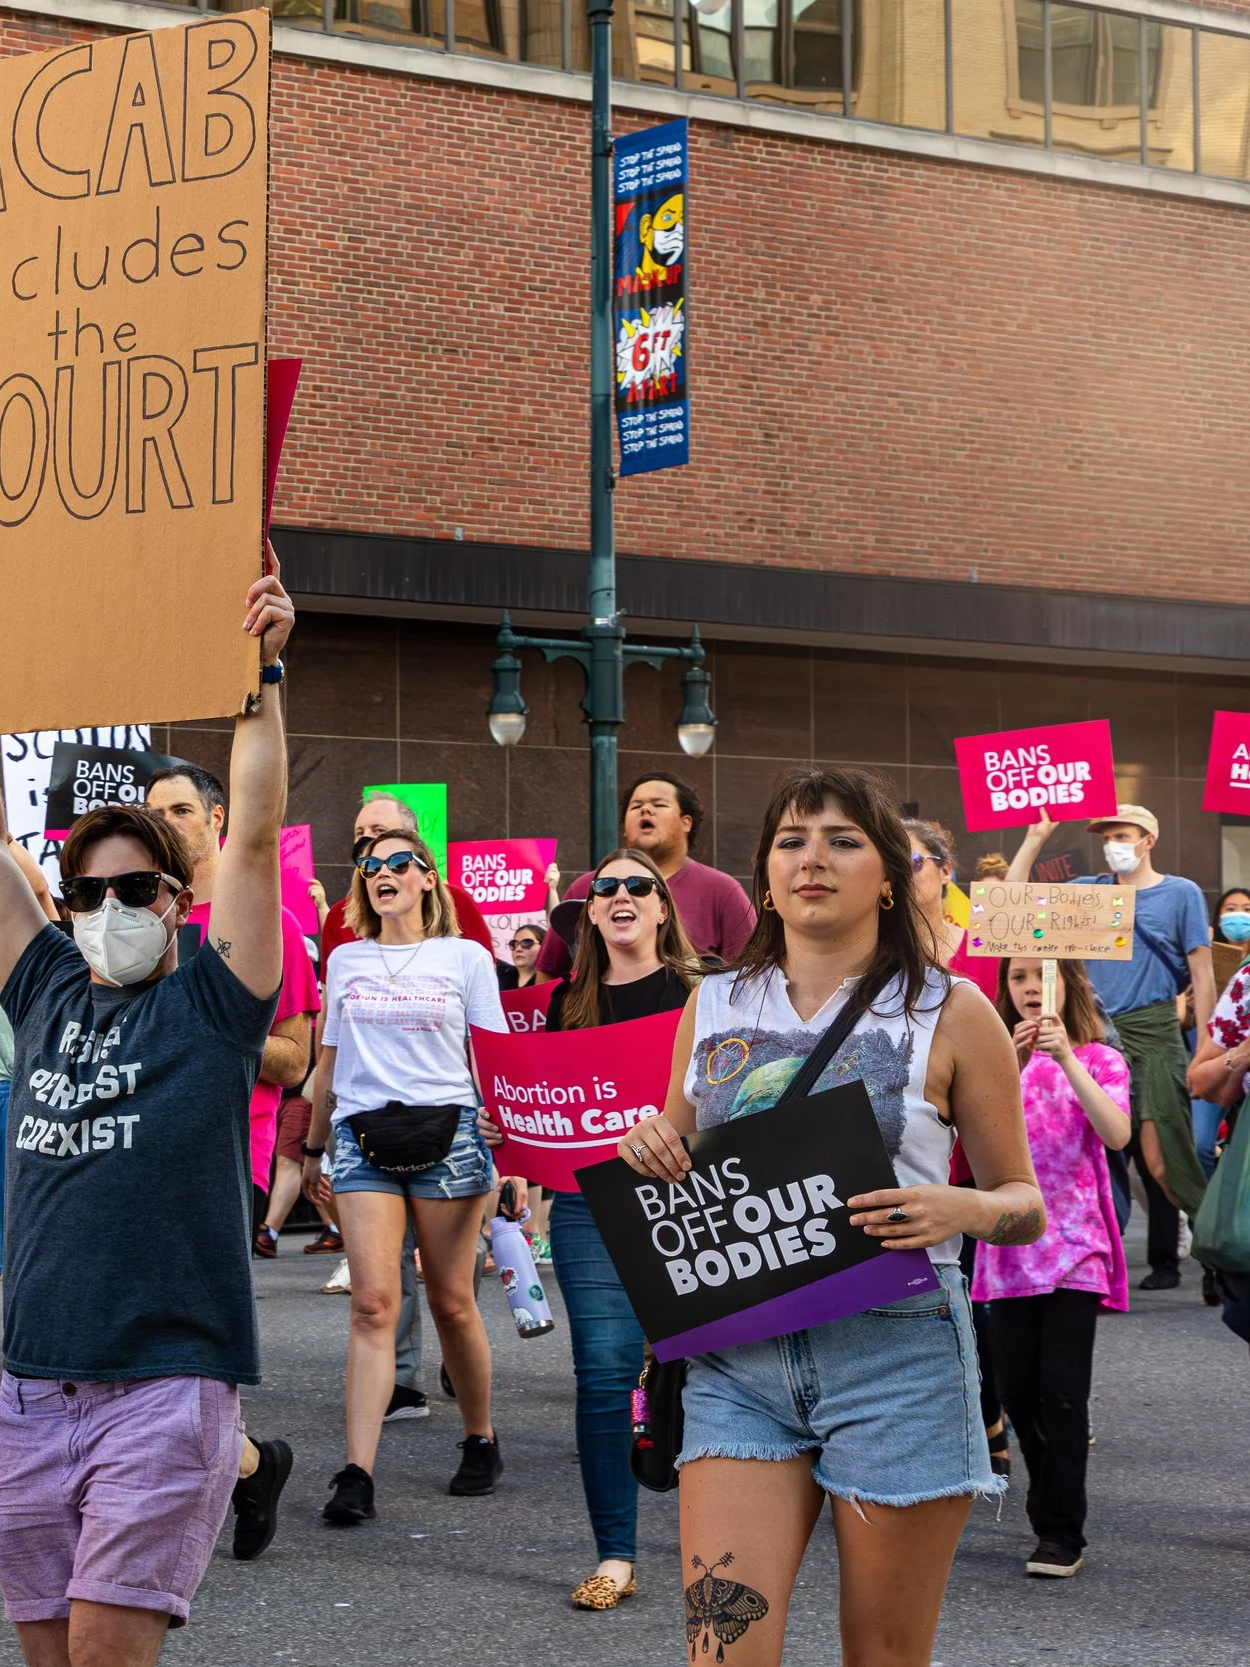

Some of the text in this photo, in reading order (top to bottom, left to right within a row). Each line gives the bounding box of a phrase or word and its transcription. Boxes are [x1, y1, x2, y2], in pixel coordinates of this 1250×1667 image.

[618, 166, 641, 180] STOP
[619, 152, 641, 168] STOP
[617, 179, 640, 193] STOP
[617, 263, 683, 297] MASK UP
[47, 307, 137, 361] the
[626, 372, 678, 403] APART
[621, 414, 644, 428] STOP
[622, 428, 644, 442] STOP
[623, 440, 645, 454] STOP
[76, 760, 135, 784] BANS
[983, 744, 1051, 772] BANS
[73, 779, 117, 800] OFF
[986, 761, 1092, 792] OFF OUR
[990, 782, 1085, 812] BODIES
[462, 853, 507, 871] BANS
[461, 868, 534, 887] OFF OUR
[989, 884, 1034, 908] OUR
[989, 912, 1037, 940] OUR
[493, 1075, 618, 1105] Abortion is
[497, 1104, 575, 1136] Health
[15, 1114, 141, 1158] COEXIST
[634, 1157, 750, 1221] BANS
[651, 1174, 845, 1257] OFF OUR
[665, 1218, 837, 1296] BODIES
